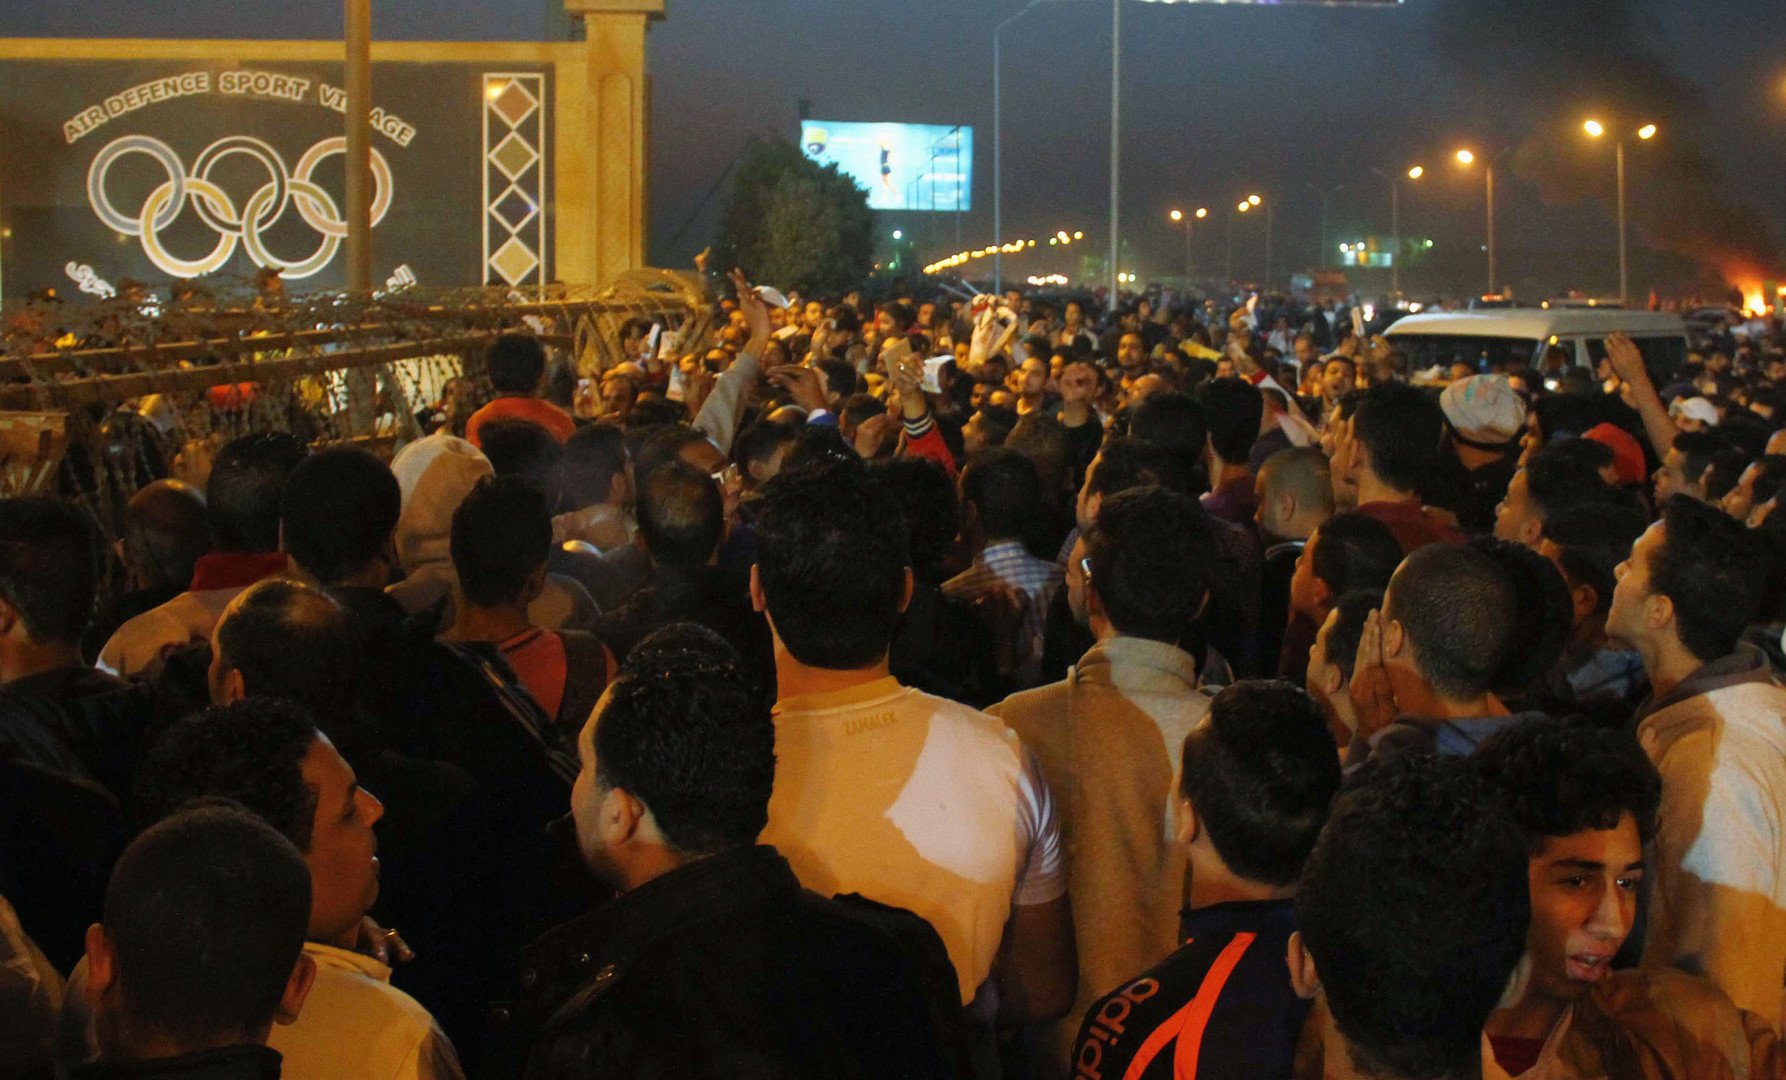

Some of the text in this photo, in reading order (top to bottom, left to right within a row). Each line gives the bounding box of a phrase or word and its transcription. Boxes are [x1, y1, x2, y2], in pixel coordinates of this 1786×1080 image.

[63, 71, 416, 147] AIR DEFENCE SPORT VIAGE
